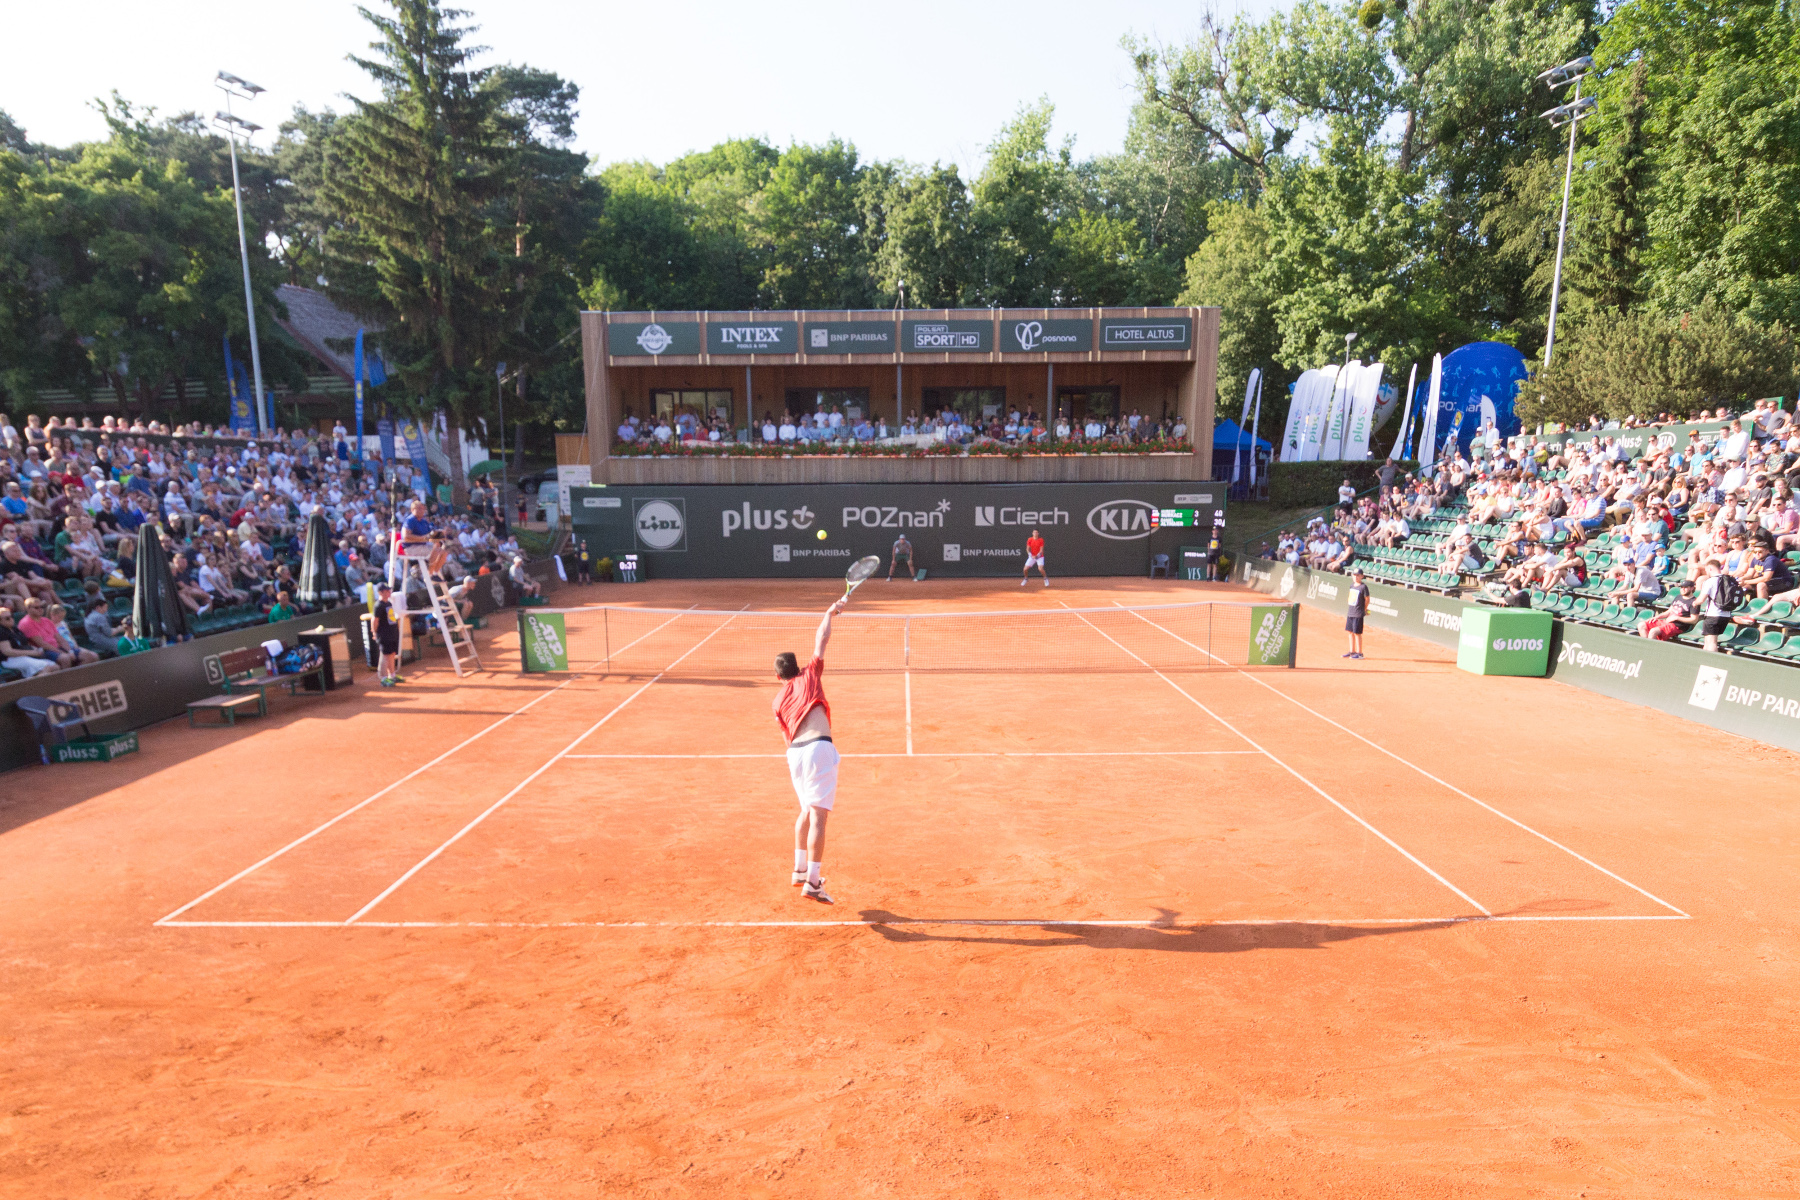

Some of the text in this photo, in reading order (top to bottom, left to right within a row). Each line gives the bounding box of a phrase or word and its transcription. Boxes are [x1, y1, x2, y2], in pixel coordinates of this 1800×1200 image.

[720, 327, 781, 343] INTEX
[850, 333, 888, 341] PARIBAS
[917, 335, 977, 346] SPORT HD
[1042, 335, 1077, 343] posnania
[1115, 329, 1174, 340] HOTEL ALTUS
[1331, 413, 1343, 440] plus
[1352, 416, 1365, 442] plus
[722, 501, 788, 538] plus
[1000, 507, 1069, 525] Ciech
[1100, 509, 1150, 531] KIA
[619, 561, 636, 570] 0:31
[1187, 568, 1201, 580] YES
[528, 616, 556, 668] CHALLENGER
[539, 621, 564, 656] ATP
[1255, 613, 1275, 651] ATP
[1261, 609, 1288, 663] CHALLENGER
[532, 642, 547, 664] TOUR
[1270, 635, 1285, 658] TOUR
[1507, 638, 1544, 650] LOTOS
[1576, 649, 1642, 680] epoznan.pl
[1725, 685, 1762, 707] BNP
[59, 746, 88, 762] plus
[109, 741, 128, 758] plus
